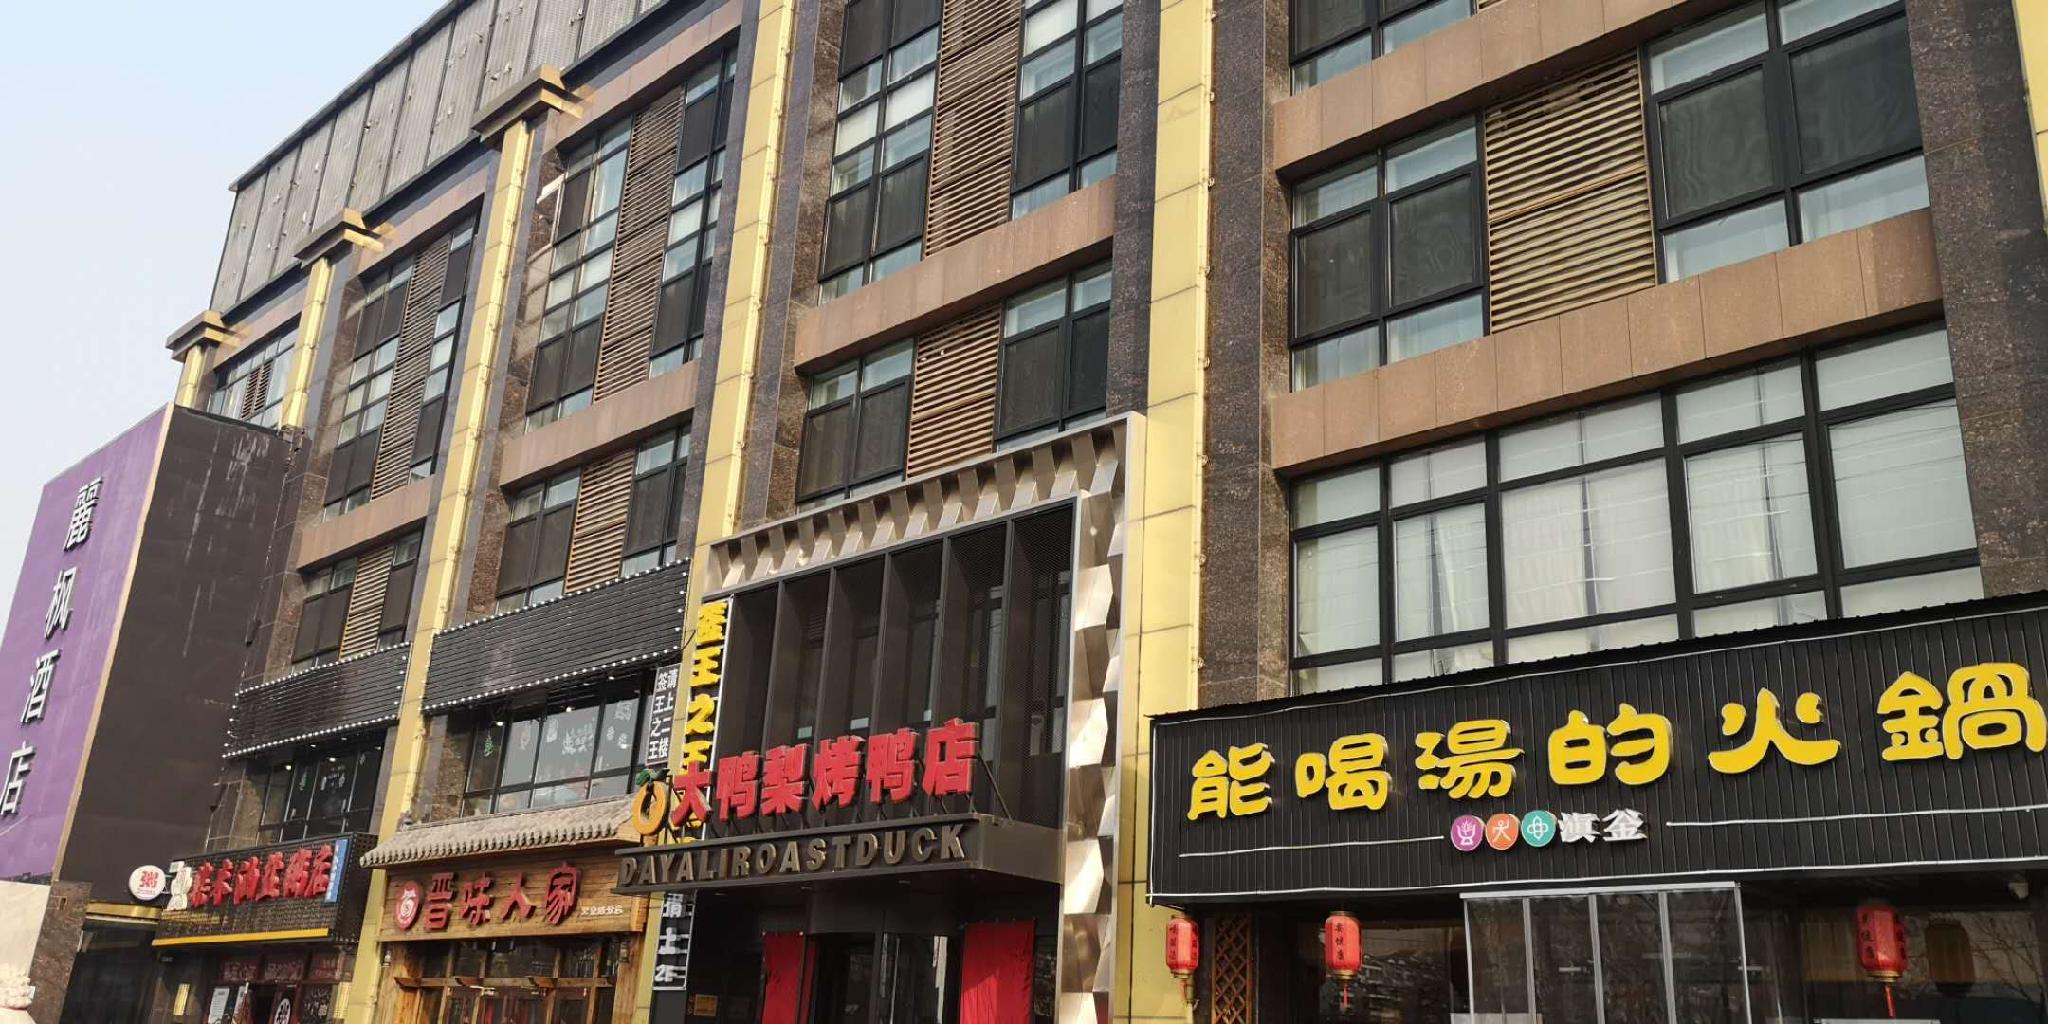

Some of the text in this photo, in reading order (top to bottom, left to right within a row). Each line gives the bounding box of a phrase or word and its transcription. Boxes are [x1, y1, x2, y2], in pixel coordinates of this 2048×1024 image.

[1, 477, 103, 816] 麗枫酒店
[658, 668, 679, 760] 请上二楼
[1187, 662, 2048, 821] 能喝湯的火鍋
[670, 717, 980, 828] 大鸭梨烤鸭店
[423, 863, 581, 931] 晋味人家
